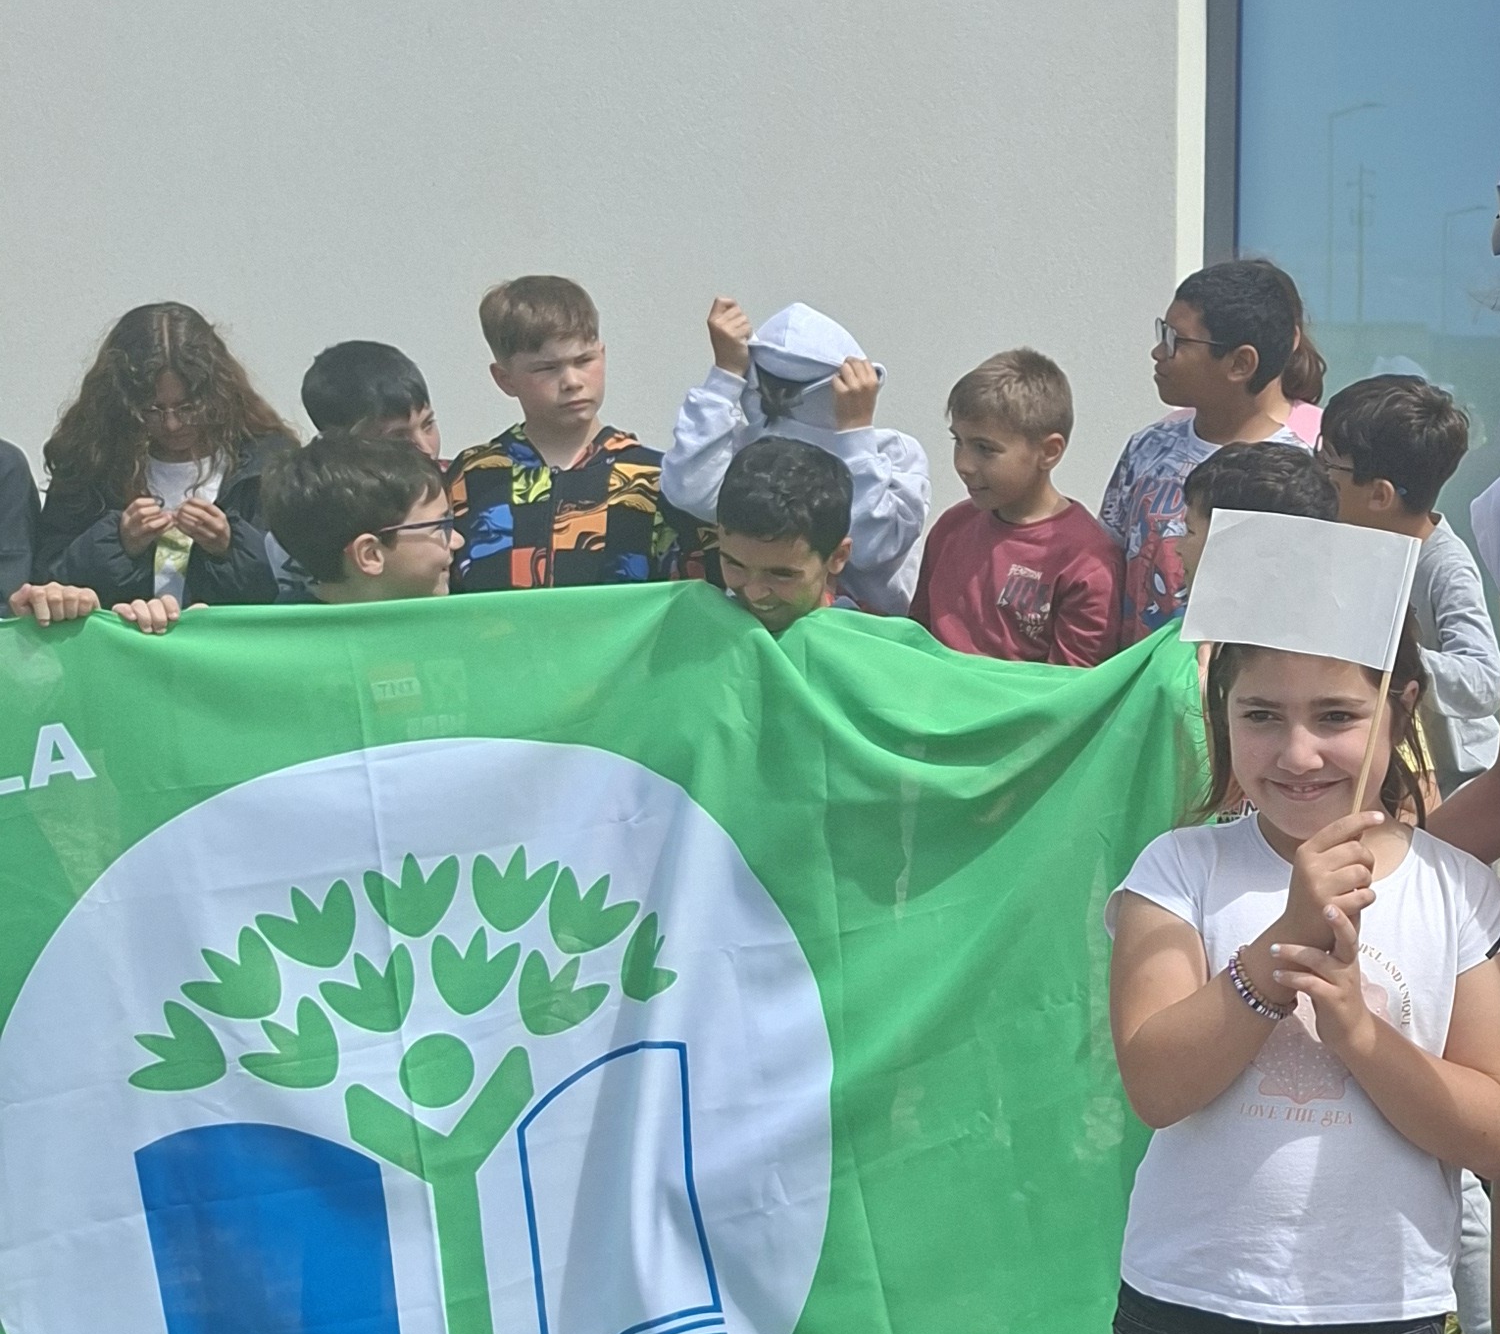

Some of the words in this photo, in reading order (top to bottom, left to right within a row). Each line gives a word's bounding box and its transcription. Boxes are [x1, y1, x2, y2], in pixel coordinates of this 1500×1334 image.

[1383, 961, 1403, 983] AND
[1239, 1102, 1280, 1120] LOVE
[1284, 1106, 1318, 1123] THE
